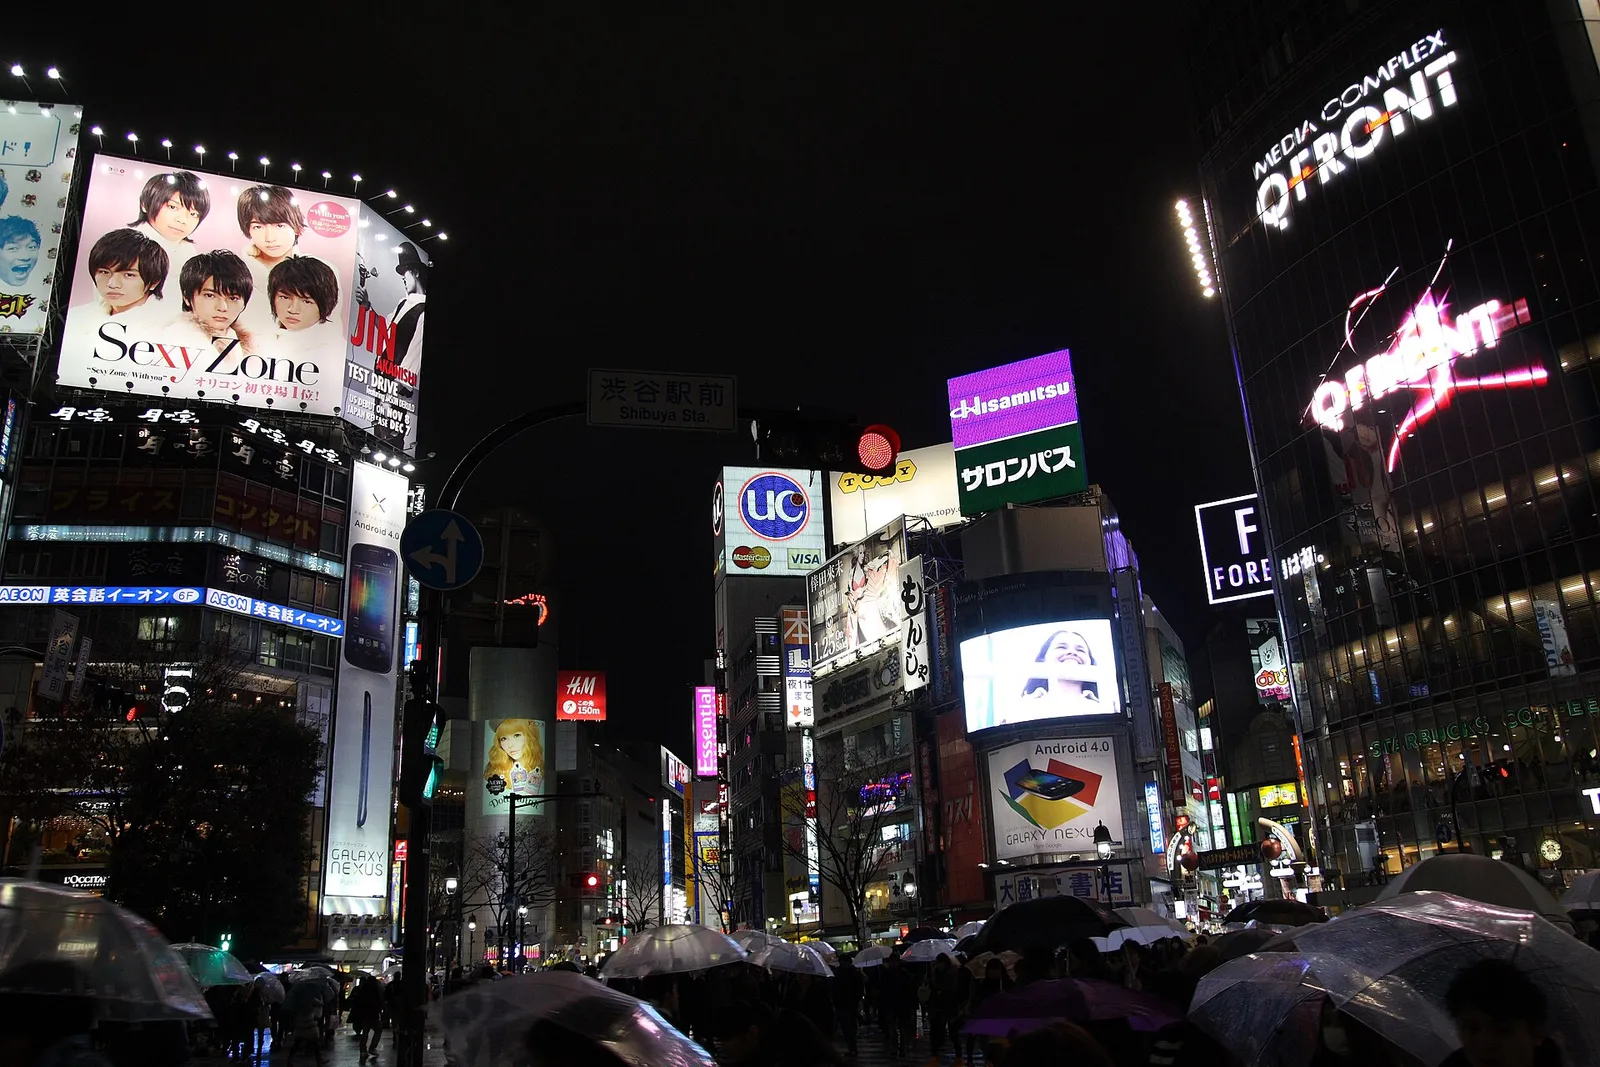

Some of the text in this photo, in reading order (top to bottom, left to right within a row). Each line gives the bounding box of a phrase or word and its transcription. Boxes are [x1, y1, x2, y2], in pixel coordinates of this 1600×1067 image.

[1253, 28, 1447, 181] MEDIA COMPLEX
[1256, 51, 1457, 231] QFRONT
[351, 304, 397, 363] JIN
[93, 322, 320, 385] Sexy Zone
[348, 362, 398, 397] TEST DRIVE
[376, 357, 418, 387] AKANISHI
[600, 377, 725, 407] 渋谷駅前
[949, 381, 1070, 419] Hisamitsu
[346, 404, 365, 420] JAPAN
[389, 419, 404, 434] DEC
[405, 425, 411, 437] 7
[349, 393, 410, 425] US DEBUT ON NOV 8
[619, 406, 710, 423] Shibuya Sta.
[844, 466, 911, 487] TOY
[961, 445, 1076, 492] サロンパス
[53, 488, 176, 513] プライス
[747, 489, 804, 522] UC
[215, 494, 318, 540] コンタクト
[354, 519, 387, 536] Android
[388, 530, 400, 540] 4.0
[1234, 506, 1258, 555] F
[193, 530, 205, 539] 7F
[218, 532, 228, 543] 7F
[733, 552, 771, 562] MasterCard
[791, 553, 820, 565] VISA
[1213, 558, 1272, 591] FORE
[0, 588, 44, 601] AEON
[53, 588, 169, 602] 英会話イーオン
[178, 591, 194, 600] 6F
[210, 591, 248, 611] AEON
[253, 601, 341, 633] 英会話イーオン
[783, 610, 810, 645] 本
[901, 574, 928, 682] もんじゃ
[814, 632, 836, 663] 1.25
[566, 676, 597, 697] H&M
[578, 706, 600, 715] 150m
[697, 688, 714, 774] Essential
[1371, 694, 1600, 758] STARBUCKS COFEE
[1035, 741, 1110, 755] Android 4.0
[1006, 828, 1095, 846] GALAXY NEXU
[331, 848, 384, 862] GALAXY
[331, 861, 384, 877] NEXUS
[1000, 870, 1123, 904] 大盛書店
